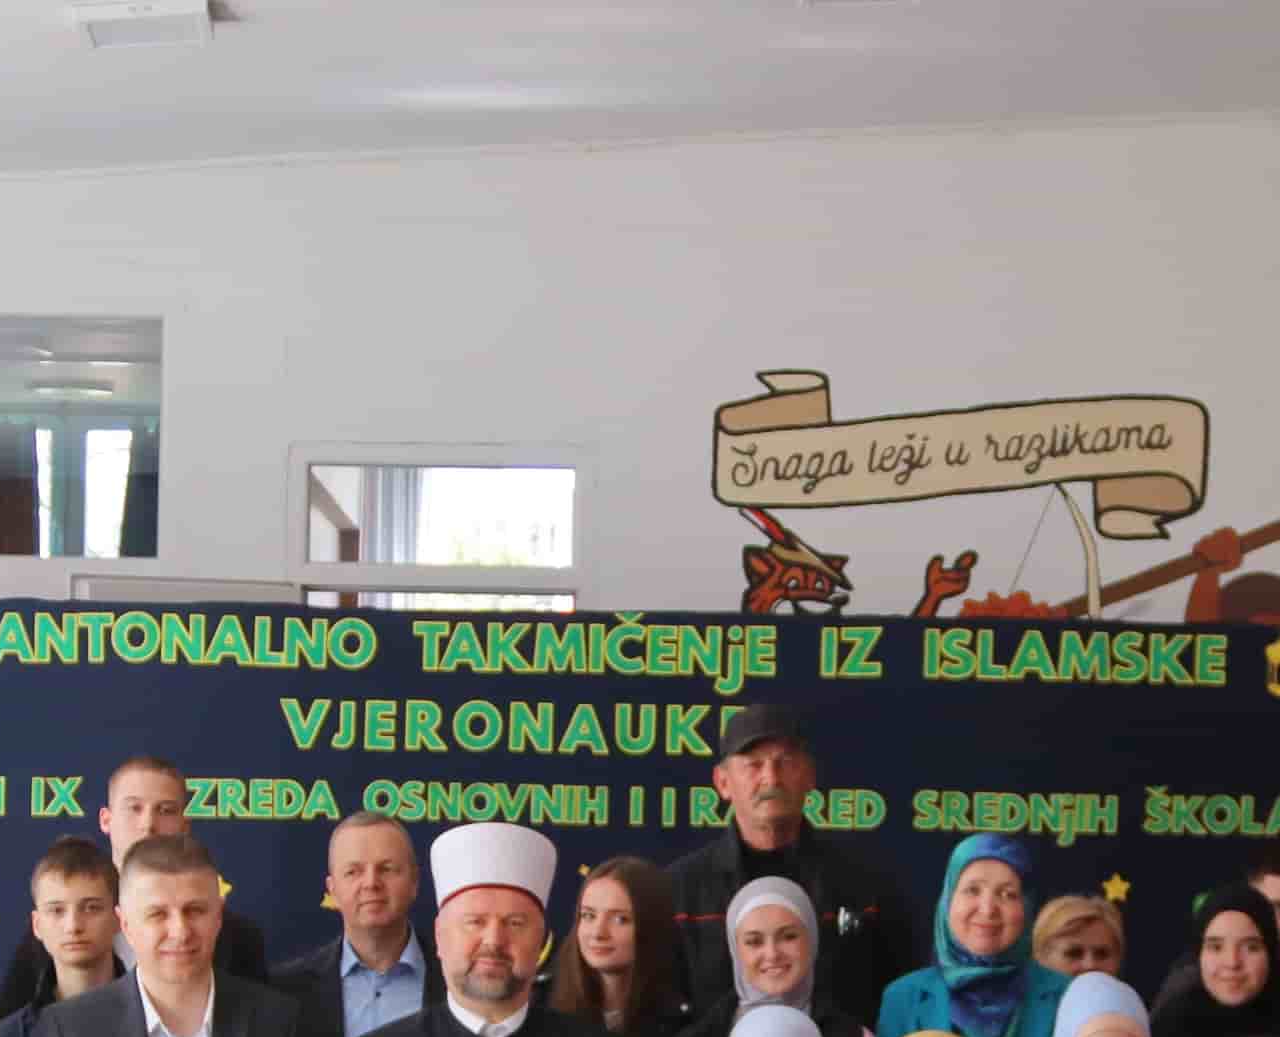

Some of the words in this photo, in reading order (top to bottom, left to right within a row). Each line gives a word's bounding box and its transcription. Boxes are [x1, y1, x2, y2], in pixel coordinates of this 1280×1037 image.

[730, 442, 854, 495] Snaga
[868, 433, 933, 485] leži
[944, 444, 971, 467] u
[985, 420, 1173, 475] razlikama
[820, 624, 884, 679] IZ
[923, 626, 1228, 685] ISLAMSKE
[30, 776, 84, 817] IX
[182, 777, 341, 820] ZREDA
[360, 778, 609, 827] OSNOVNIH
[628, 785, 645, 827] I
[661, 786, 677, 828] I
